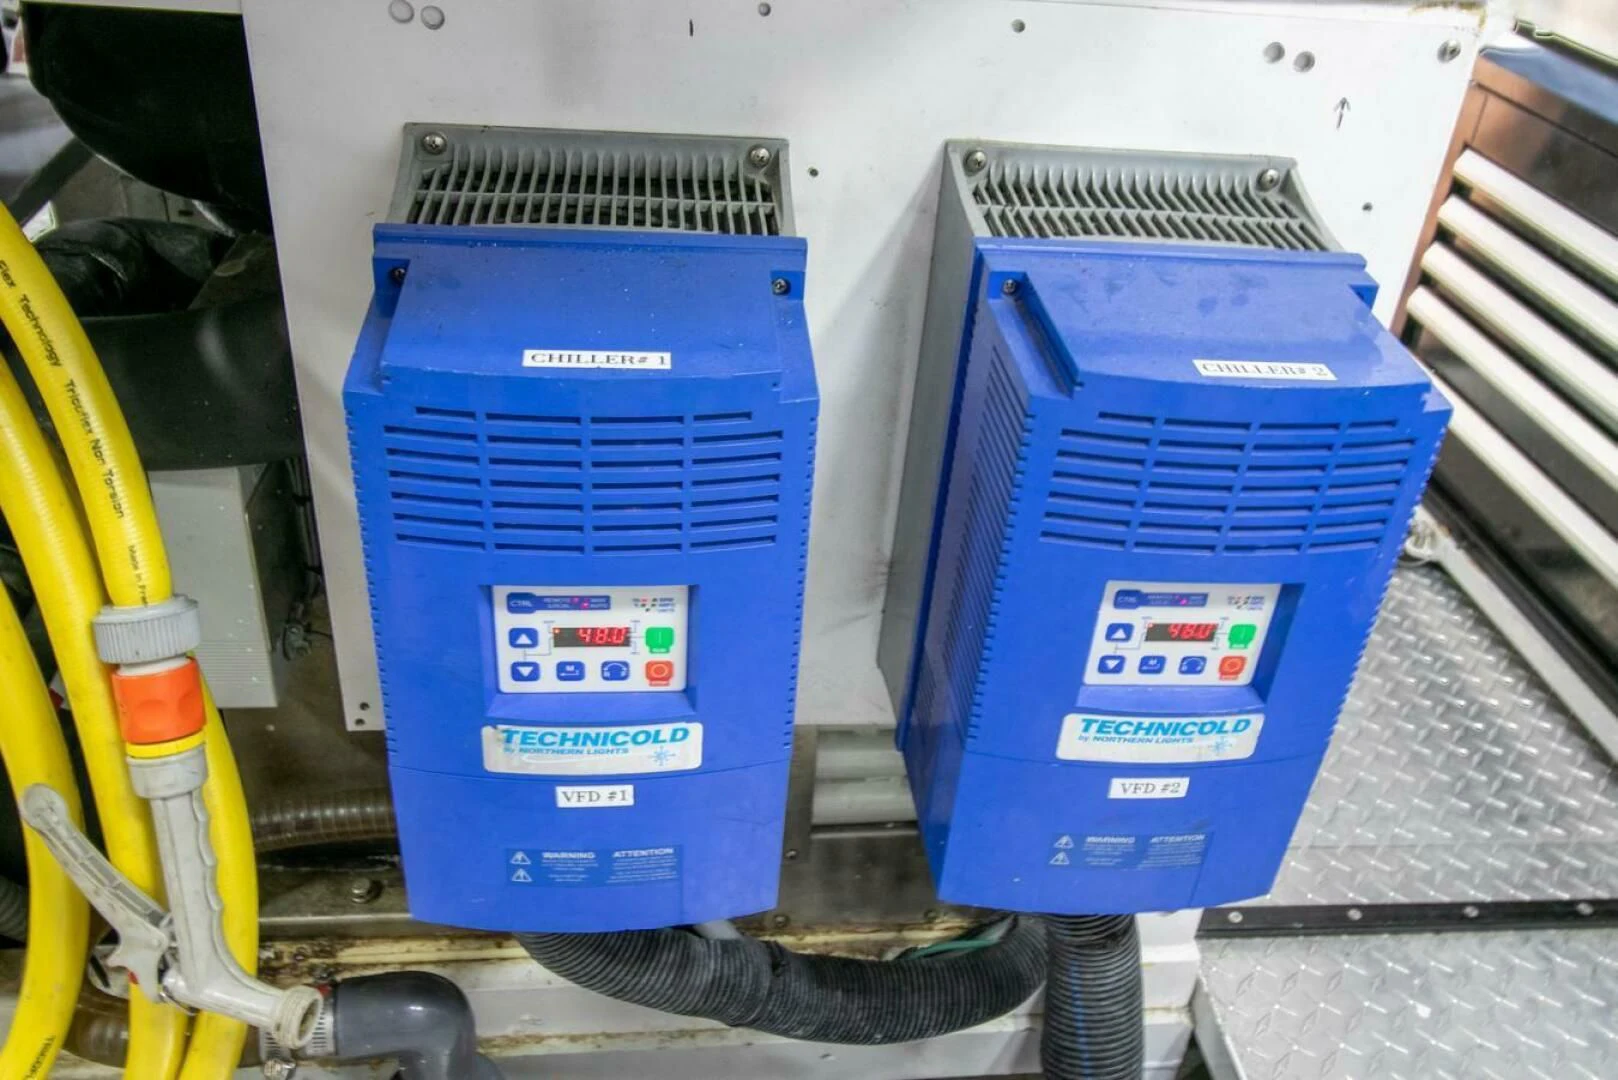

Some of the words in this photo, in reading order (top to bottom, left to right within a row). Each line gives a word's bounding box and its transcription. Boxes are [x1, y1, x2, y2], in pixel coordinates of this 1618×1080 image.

[20, 294, 62, 367] Technology
[531, 353, 648, 365] CHILLER#
[659, 355, 666, 366] 1
[1312, 367, 1328, 377] 2
[91, 438, 105, 465] Non
[103, 469, 125, 519] Torsion
[577, 626, 627, 645] 48.0
[1081, 718, 1251, 736] TECHNICOLD
[501, 727, 690, 747] TECHNICOLD
[1078, 735, 1089, 743] by
[1093, 736, 1154, 744] NORTHERN
[1155, 736, 1194, 744] LIGHTS
[1120, 782, 1155, 795] VFD
[1160, 782, 1181, 794] #2
[562, 790, 601, 803] VFD
[607, 789, 628, 802] #1
[1085, 836, 1136, 844] WARNING
[1149, 834, 1206, 844] ATTENTION
[541, 851, 596, 860] WARNING
[612, 848, 675, 858] ATTENTION
